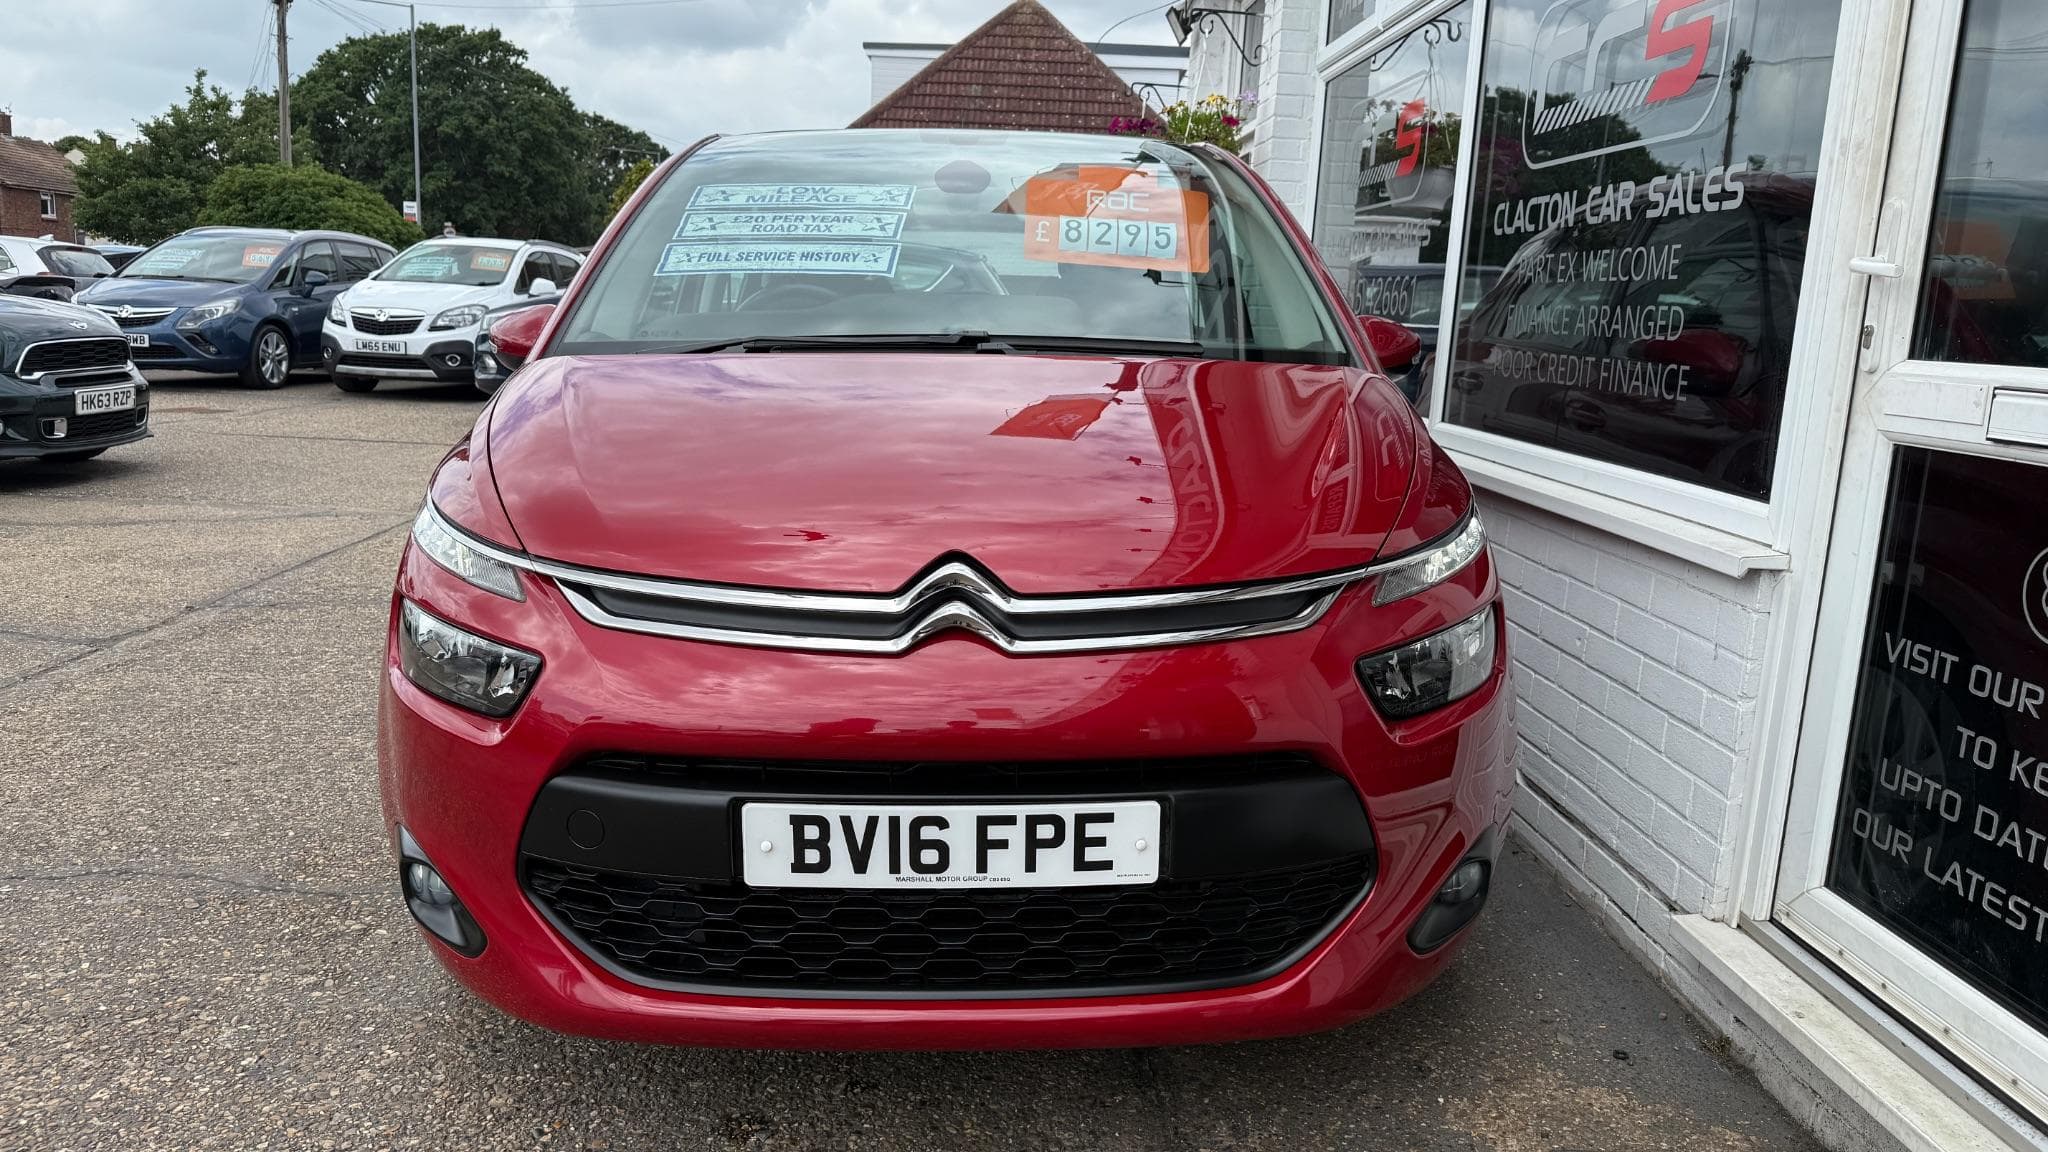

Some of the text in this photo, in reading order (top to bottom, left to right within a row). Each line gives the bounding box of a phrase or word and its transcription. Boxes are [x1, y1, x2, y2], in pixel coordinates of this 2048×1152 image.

[744, 194, 858, 203] MILEAGE
[775, 186, 835, 195] LOW
[1494, 161, 1748, 235] CLACTON CAR SALES
[730, 215, 854, 224] £20 PER YEAR
[750, 224, 834, 233] ROAD TAX
[696, 251, 861, 263] FULL SERVICE HISTORY
[1518, 244, 1682, 284] PART EX WELCOME
[1507, 304, 1685, 341] FINANCE ARRANGED
[381, 342, 401, 352] ENU
[1537, 352, 1595, 388] CREDIT
[1598, 358, 1690, 401] FINANCE
[81, 390, 131, 411] HK63 RZP
[1885, 631, 2045, 719] VISIT OUR
[1956, 725, 1997, 770] TO
[1880, 758, 2048, 871] UPTO DAT
[789, 812, 1115, 874] BV16 FPE
[1852, 807, 2048, 943] OUR LATEST
